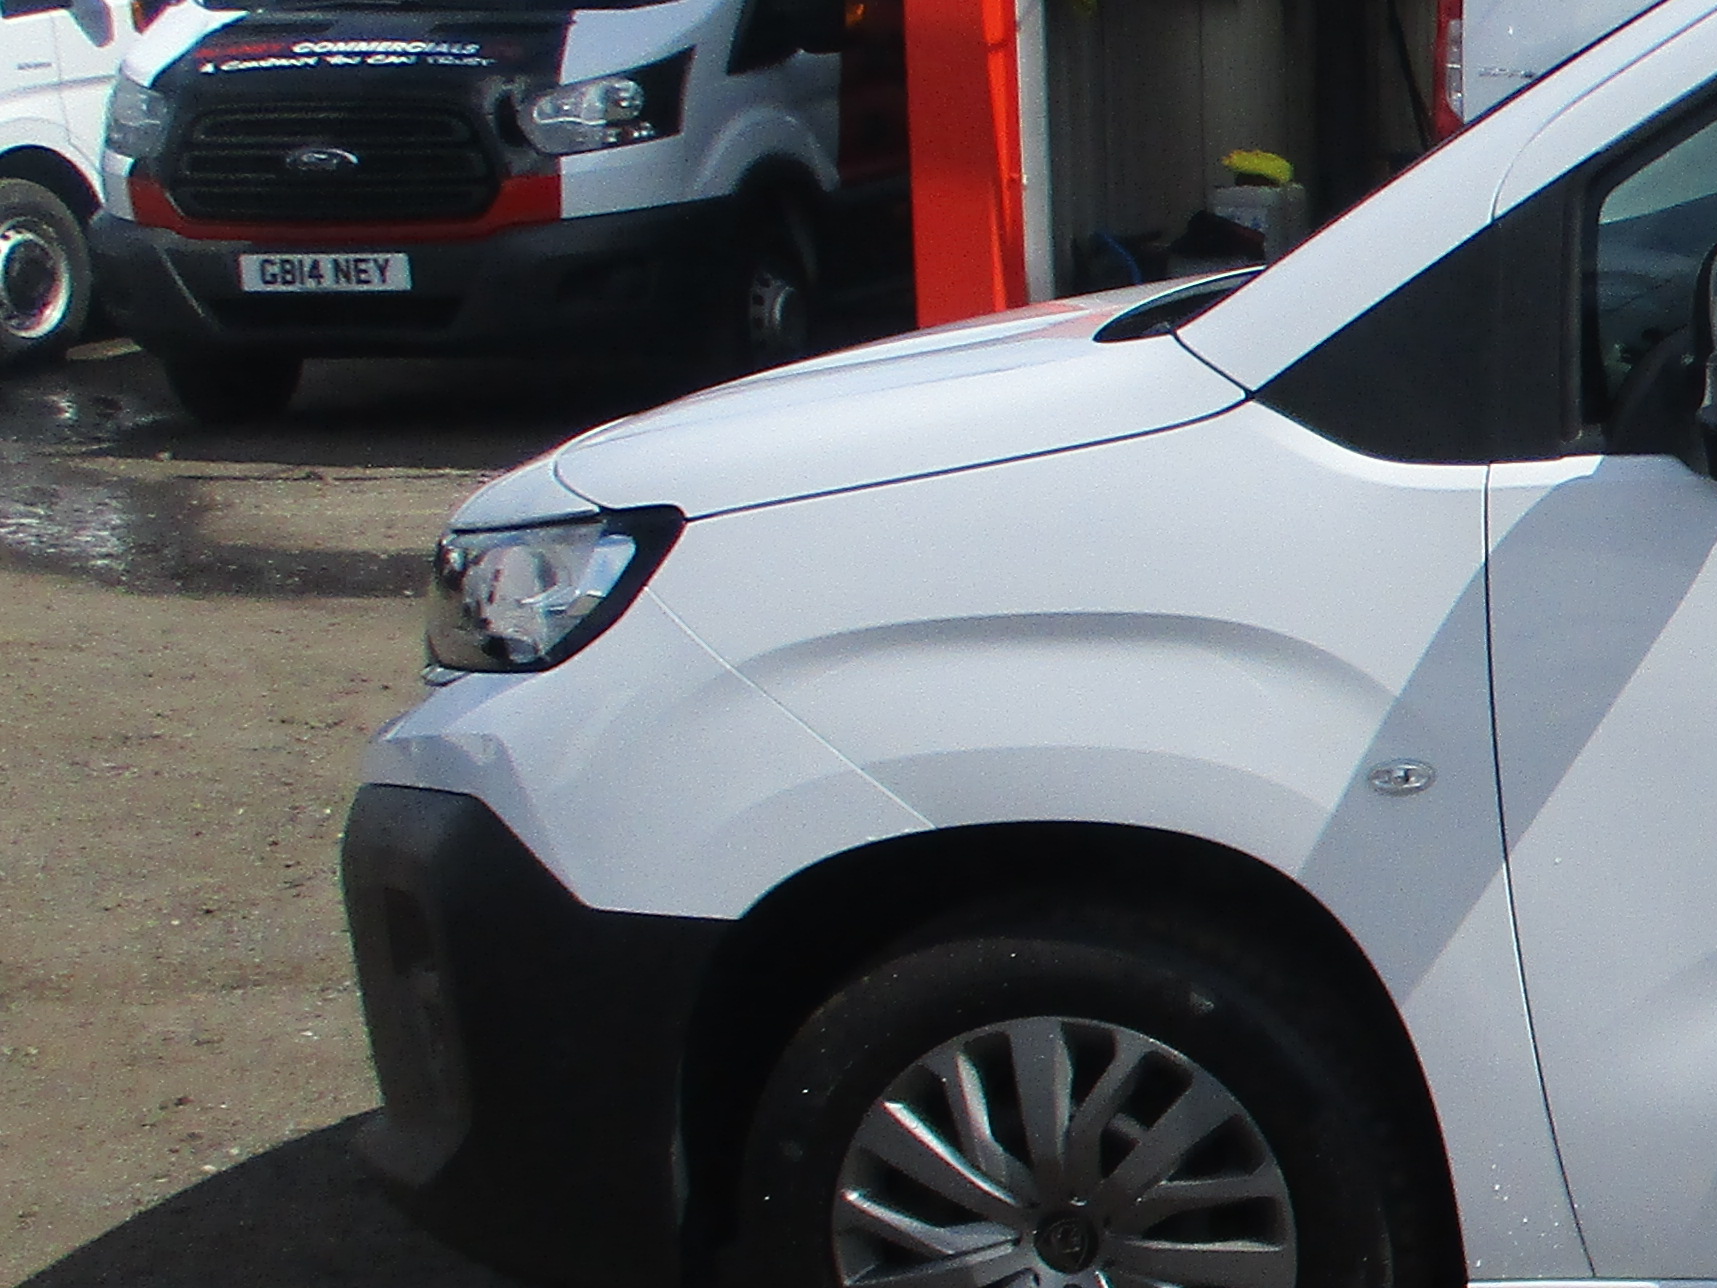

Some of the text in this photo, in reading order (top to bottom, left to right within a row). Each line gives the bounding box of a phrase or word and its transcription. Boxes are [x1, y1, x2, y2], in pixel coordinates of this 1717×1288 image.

[292, 41, 480, 54] COMMERCIALS
[259, 258, 390, 286] GB14 NEY
